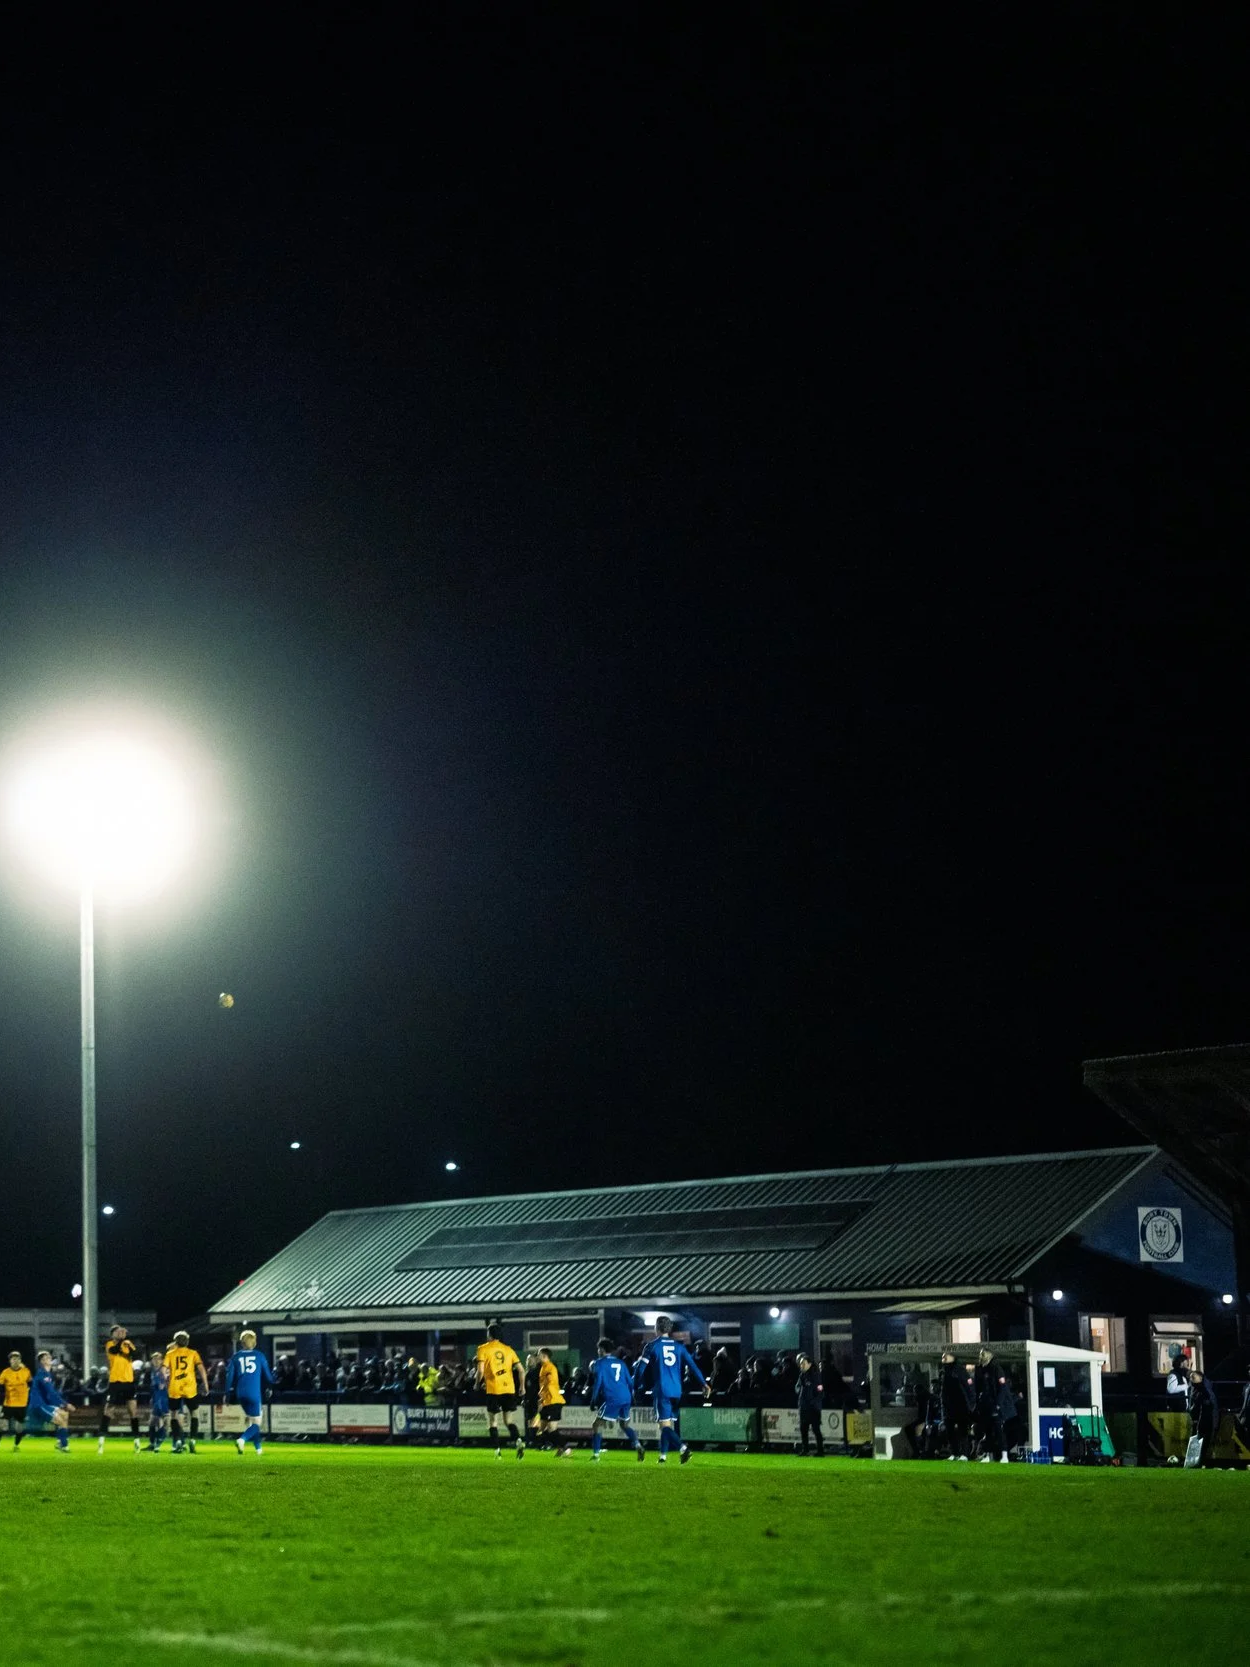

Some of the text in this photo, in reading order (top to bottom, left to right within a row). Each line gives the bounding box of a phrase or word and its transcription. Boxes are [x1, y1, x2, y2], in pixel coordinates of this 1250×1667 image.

[176, 1356, 188, 1370] 15
[495, 1351, 505, 1364] 9
[662, 1346, 676, 1367] 5
[238, 1356, 257, 1374] 15
[611, 1363, 622, 1382] 7
[407, 1408, 455, 1419] BURY TOWN FC
